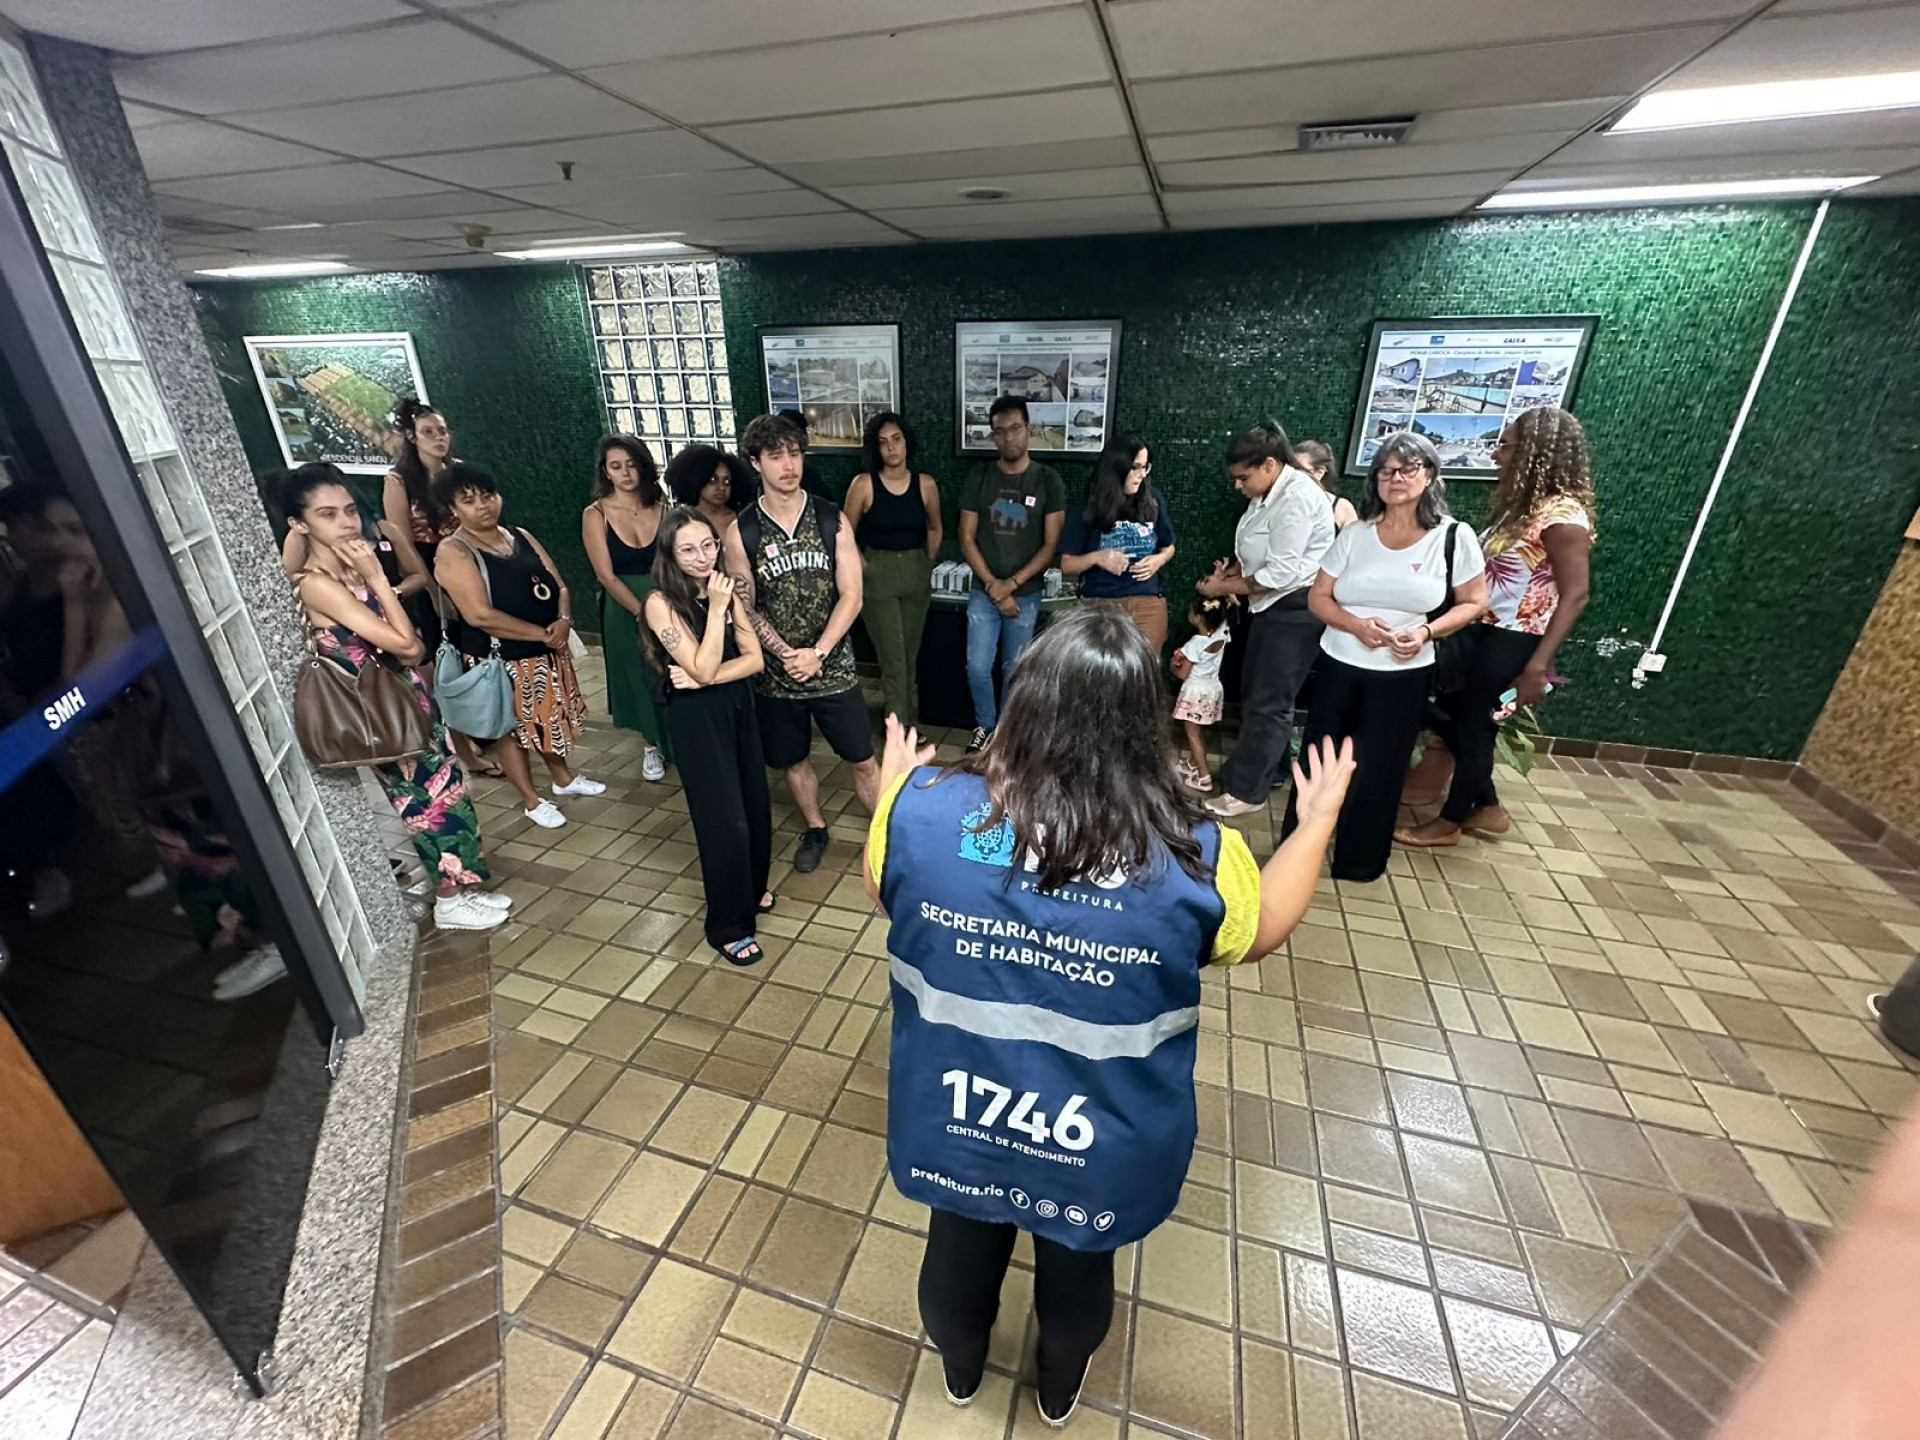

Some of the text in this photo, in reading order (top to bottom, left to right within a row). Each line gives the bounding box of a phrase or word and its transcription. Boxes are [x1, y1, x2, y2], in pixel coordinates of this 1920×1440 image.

[43, 686, 87, 730] SMH
[1020, 881, 1124, 912] PRFEITURA
[920, 901, 1162, 966] SECRETARIA MUNICIPAL
[956, 939, 1115, 987] DE HABITAÇÃO
[942, 1069, 1095, 1151] 1746
[946, 1124, 1086, 1167] CENTRAL DE ATENDIMENTO
[911, 1167, 1004, 1197] prefeitura.rio
